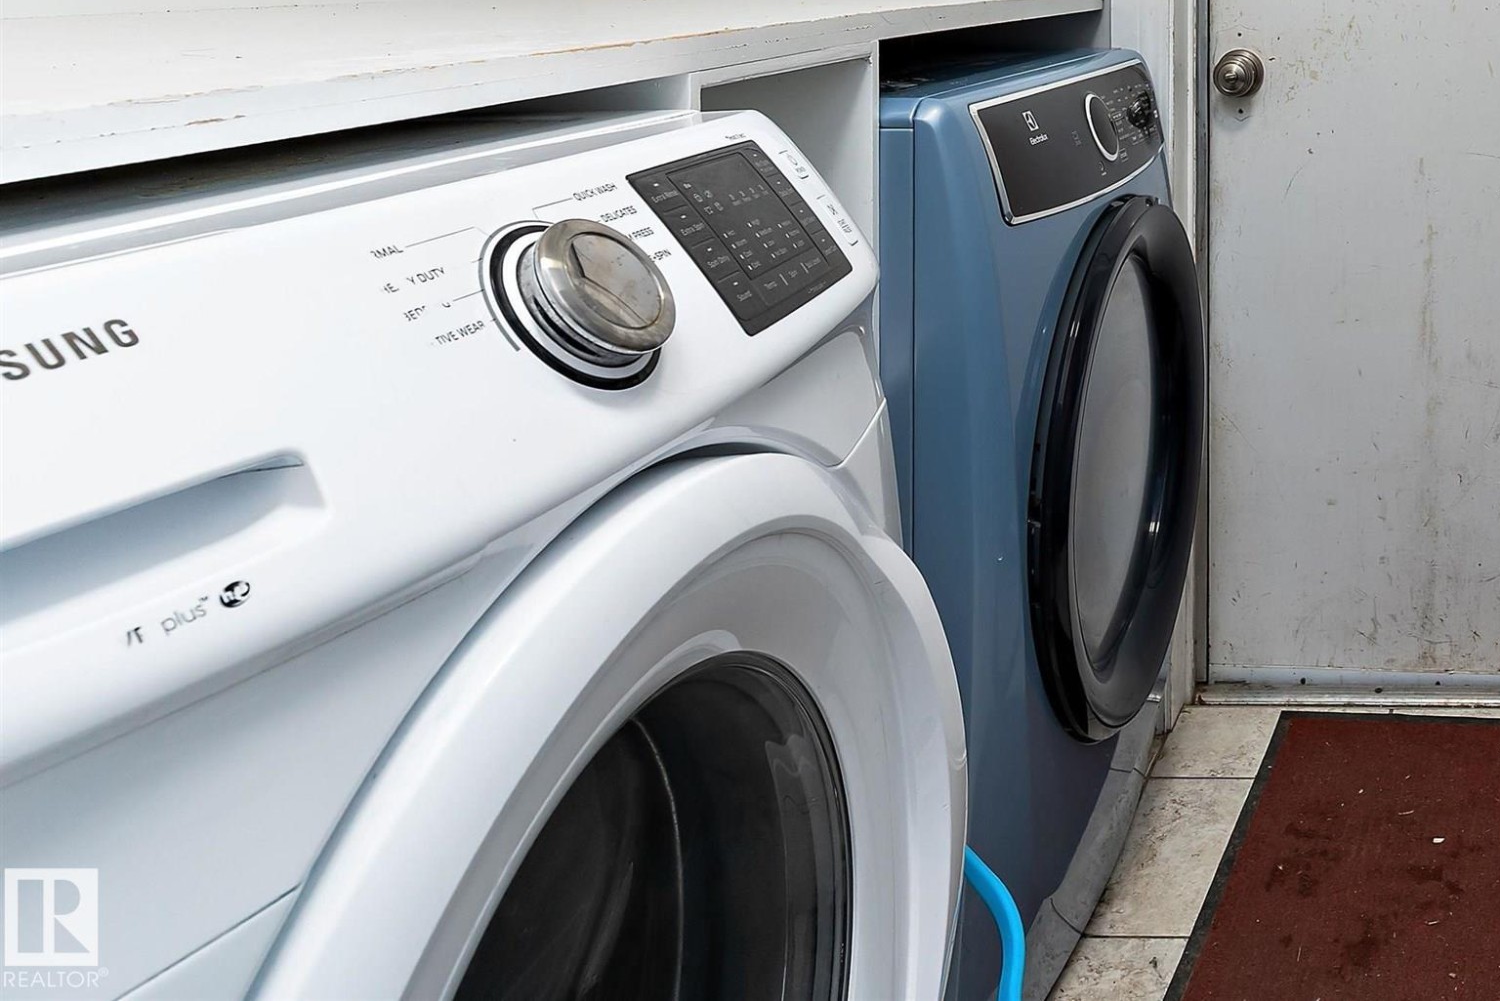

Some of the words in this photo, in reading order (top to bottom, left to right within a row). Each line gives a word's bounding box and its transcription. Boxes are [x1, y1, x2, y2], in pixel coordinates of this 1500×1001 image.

[600, 205, 637, 222] DELICATES
[416, 267, 445, 283] DUTY
[456, 320, 485, 338] WEAR
